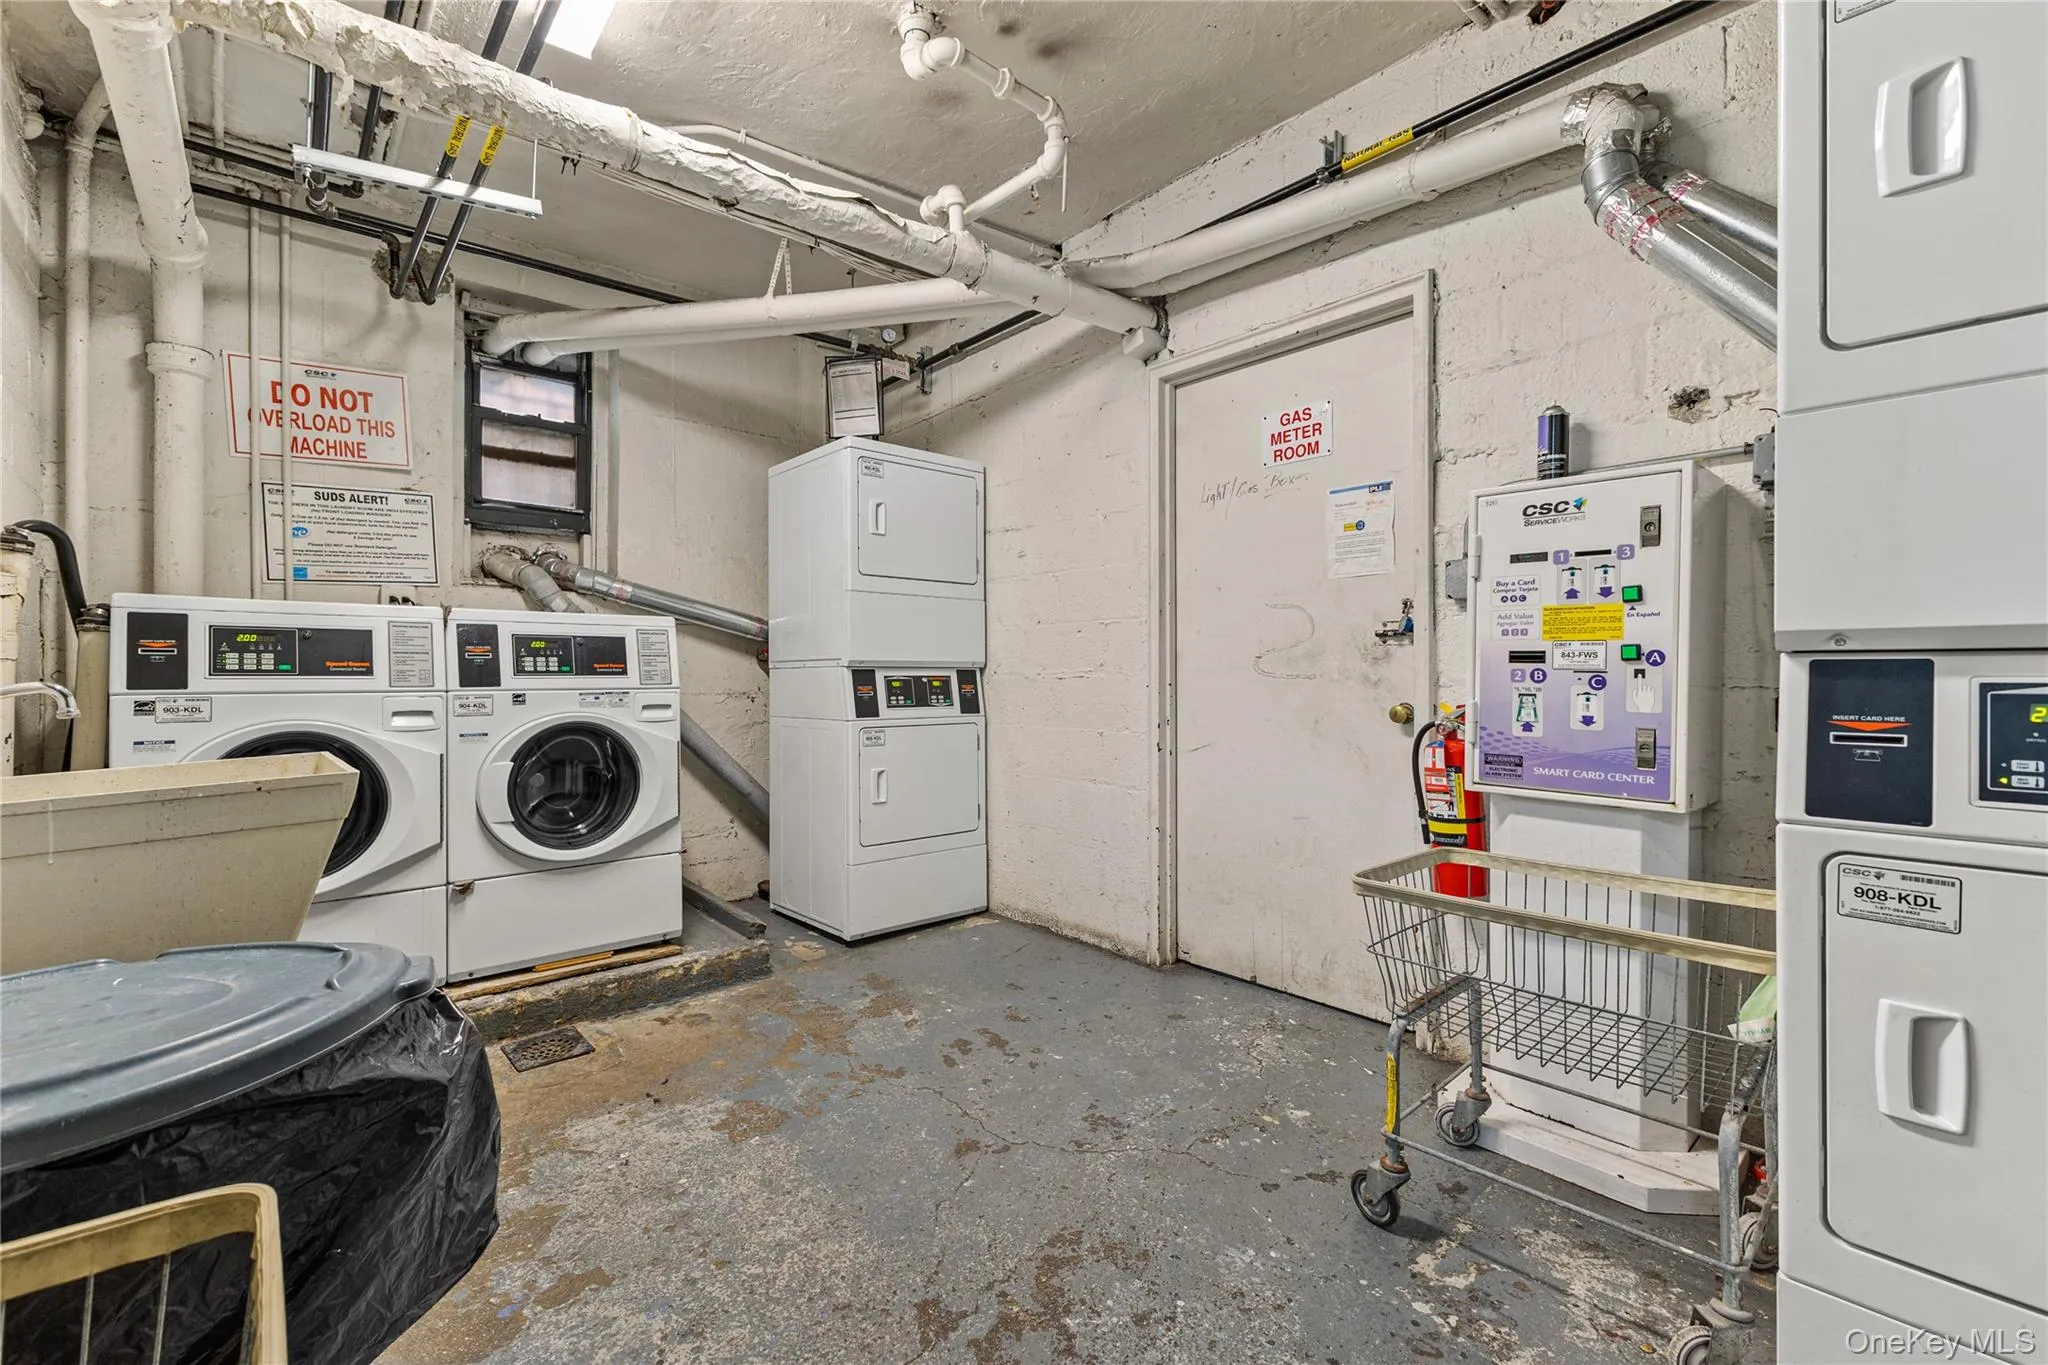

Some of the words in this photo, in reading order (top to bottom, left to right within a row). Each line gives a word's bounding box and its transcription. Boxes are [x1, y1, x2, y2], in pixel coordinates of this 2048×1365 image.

[271, 380, 310, 407] DO
[320, 386, 373, 414] NOT
[1280, 407, 1312, 426] GAS
[357, 418, 395, 438] THIS
[1270, 422, 1322, 446] METER
[290, 436, 368, 459] MACHINE
[1273, 441, 1320, 462] ROOM
[314, 492, 345, 502] SUDS
[349, 494, 388, 506] ALERT!
[1522, 500, 1570, 517] CSC
[1649, 652, 1661, 663] A
[2030, 707, 2048, 722] 2
[1533, 767, 1569, 777] SMART
[1572, 769, 1605, 780] CARD
[1607, 773, 1655, 784] CENTER
[1842, 867, 1872, 877] CSC
[1854, 886, 1942, 910] 908-KDL
